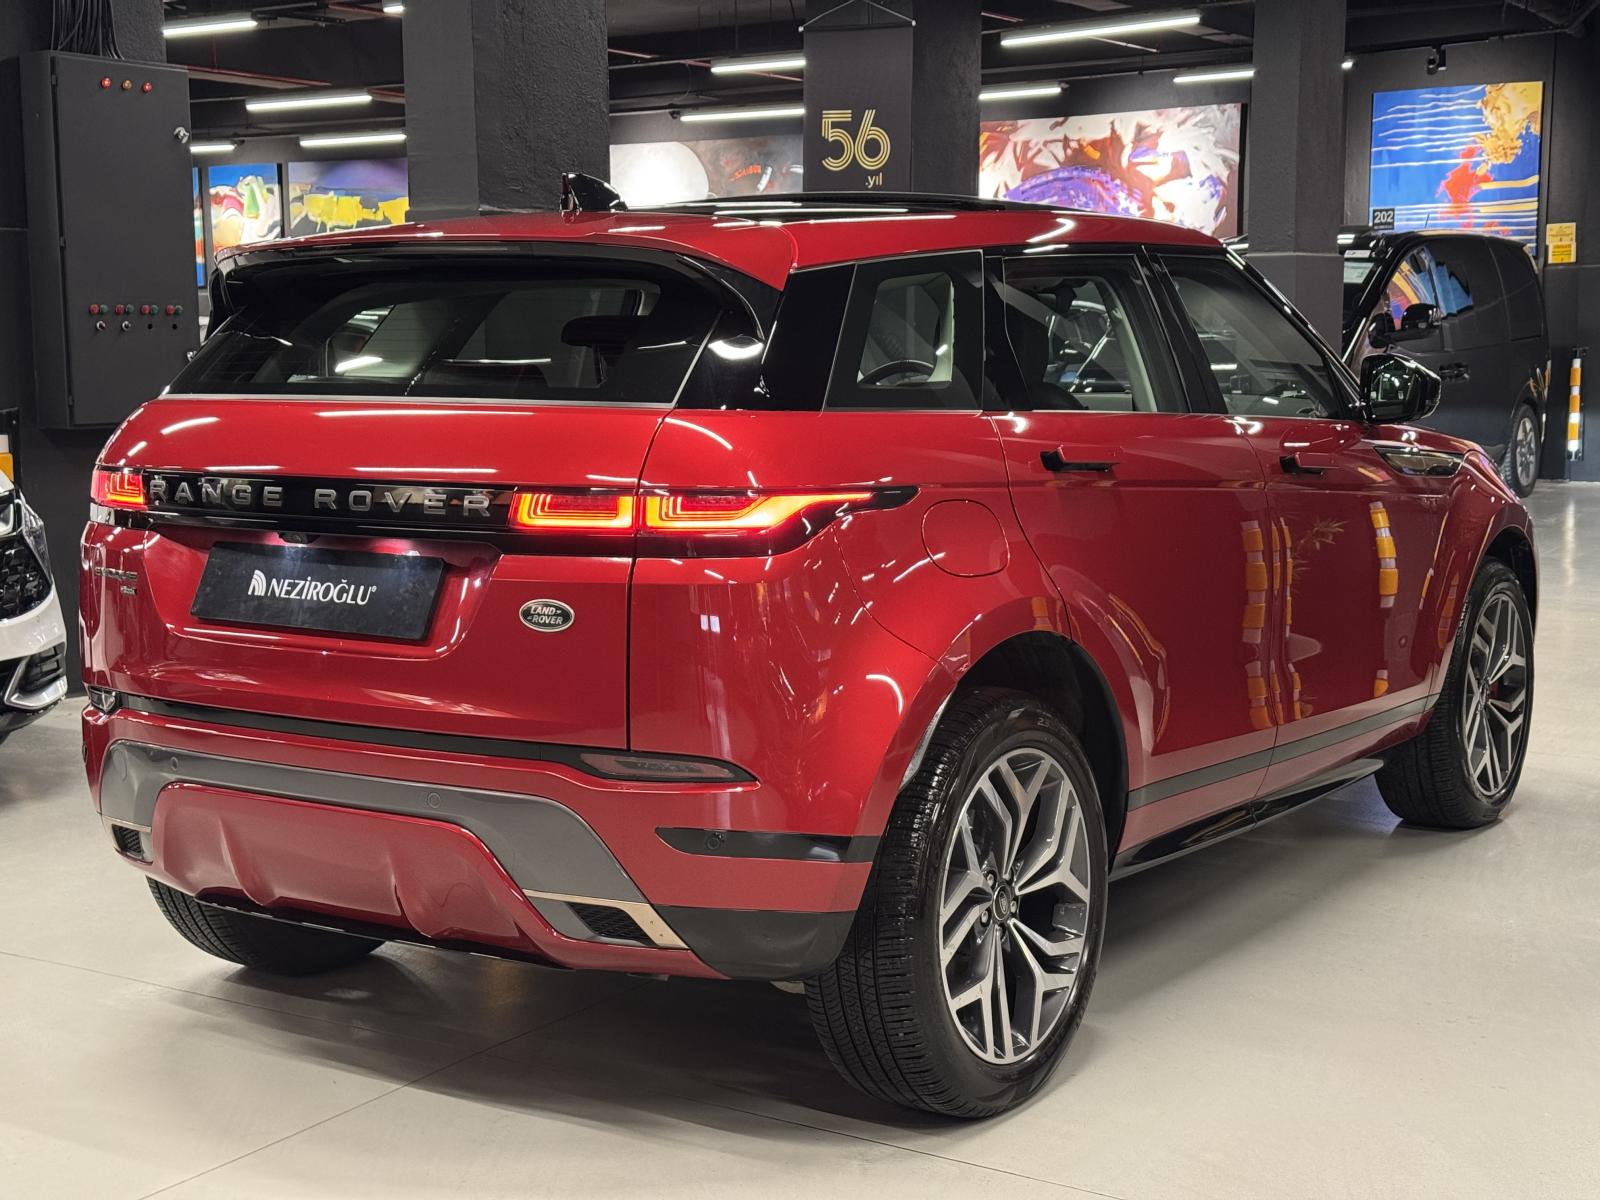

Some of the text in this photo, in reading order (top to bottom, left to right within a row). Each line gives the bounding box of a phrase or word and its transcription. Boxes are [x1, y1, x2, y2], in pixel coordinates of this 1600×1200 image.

[822, 109, 891, 171] 56
[1374, 210, 1394, 224] 202
[149, 479, 491, 517] RANGE ROVER
[530, 605, 556, 615] LAND
[531, 615, 564, 625] ROVER
